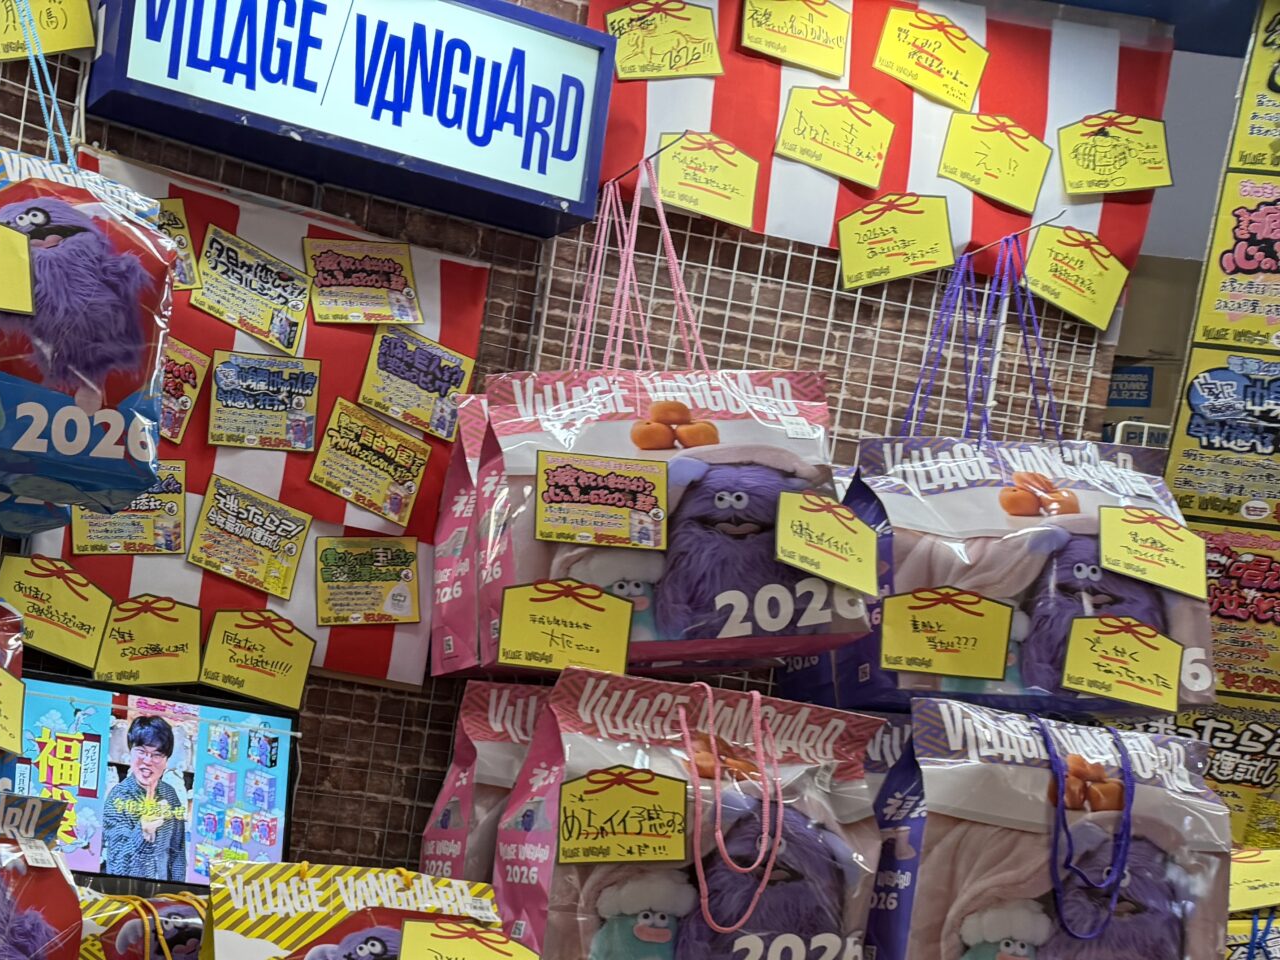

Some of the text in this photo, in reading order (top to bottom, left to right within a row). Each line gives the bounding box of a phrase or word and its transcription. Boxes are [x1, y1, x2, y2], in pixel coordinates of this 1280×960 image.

[145, 0, 586, 176] VILLAGE VANGUARD
[513, 377, 635, 422] VILLAGE
[13, 402, 157, 464] 2026
[577, 677, 691, 742] VILLAGE
[225, 875, 478, 919] VILLAGE VANGUARD
[505, 864, 539, 886] 2026
